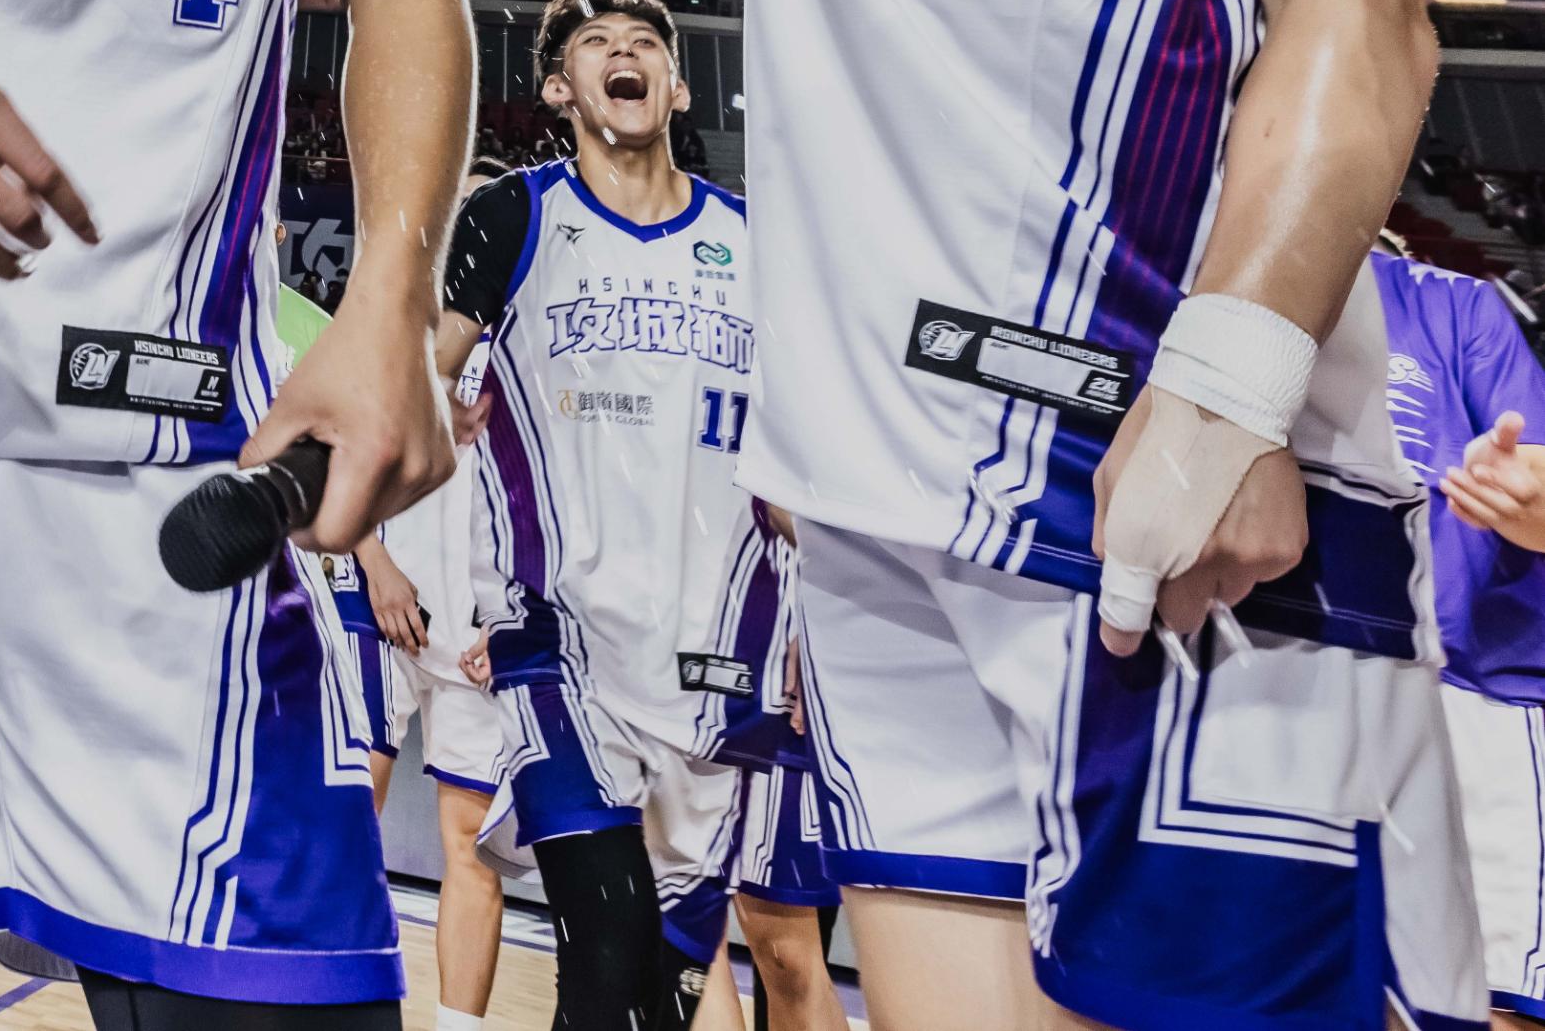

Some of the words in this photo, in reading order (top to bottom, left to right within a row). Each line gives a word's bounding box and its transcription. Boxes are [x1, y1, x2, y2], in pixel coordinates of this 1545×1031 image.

[578, 276, 727, 306] HSINCHU
[546, 297, 754, 374] 攻城獅
[696, 386, 749, 454] 11
